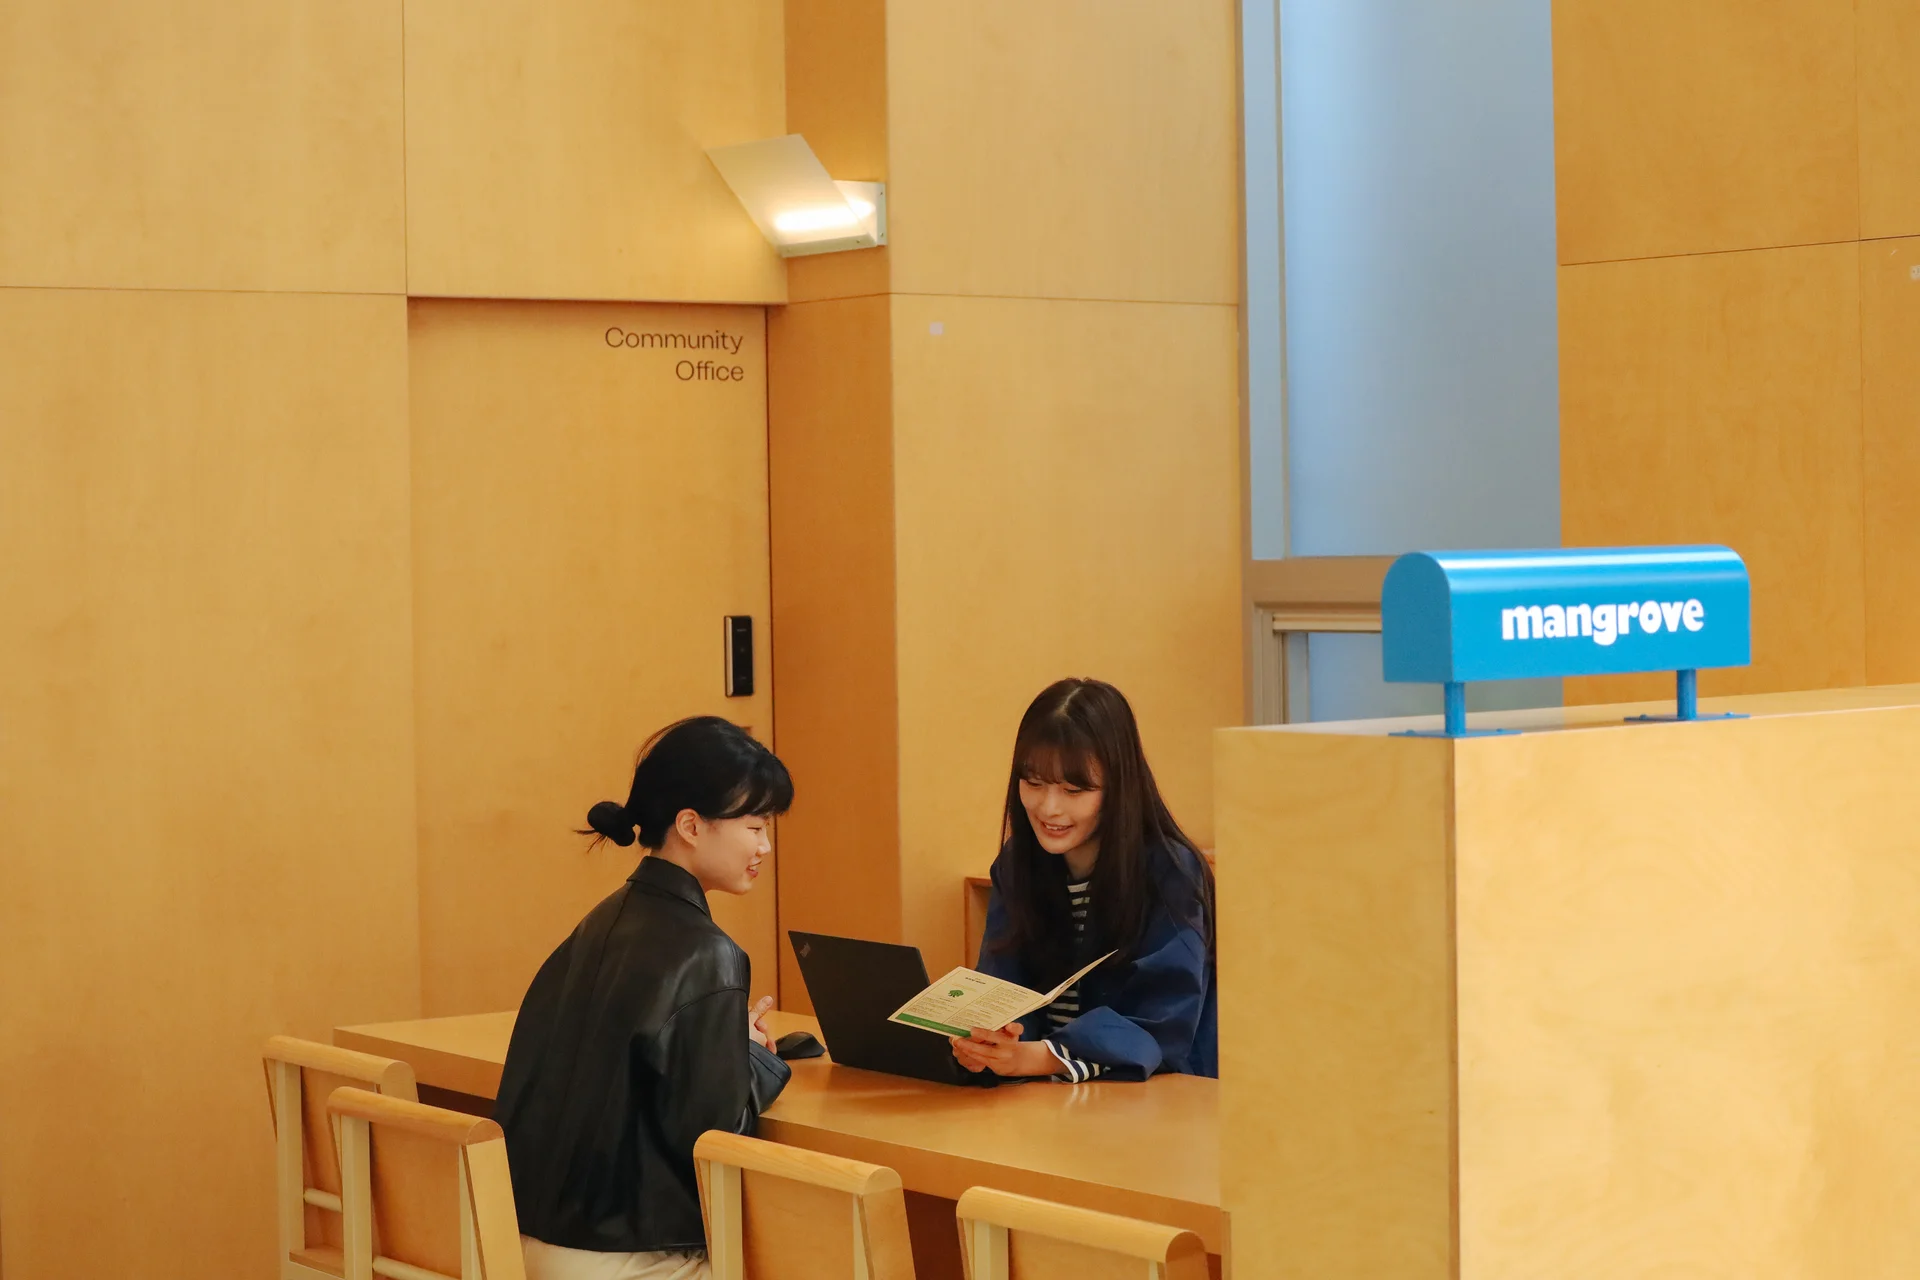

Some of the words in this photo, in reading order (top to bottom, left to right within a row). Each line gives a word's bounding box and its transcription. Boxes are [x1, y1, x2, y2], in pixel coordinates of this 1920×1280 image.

[605, 327, 744, 354] Community
[675, 360, 744, 381] Office
[1501, 598, 1704, 646] mangrove
